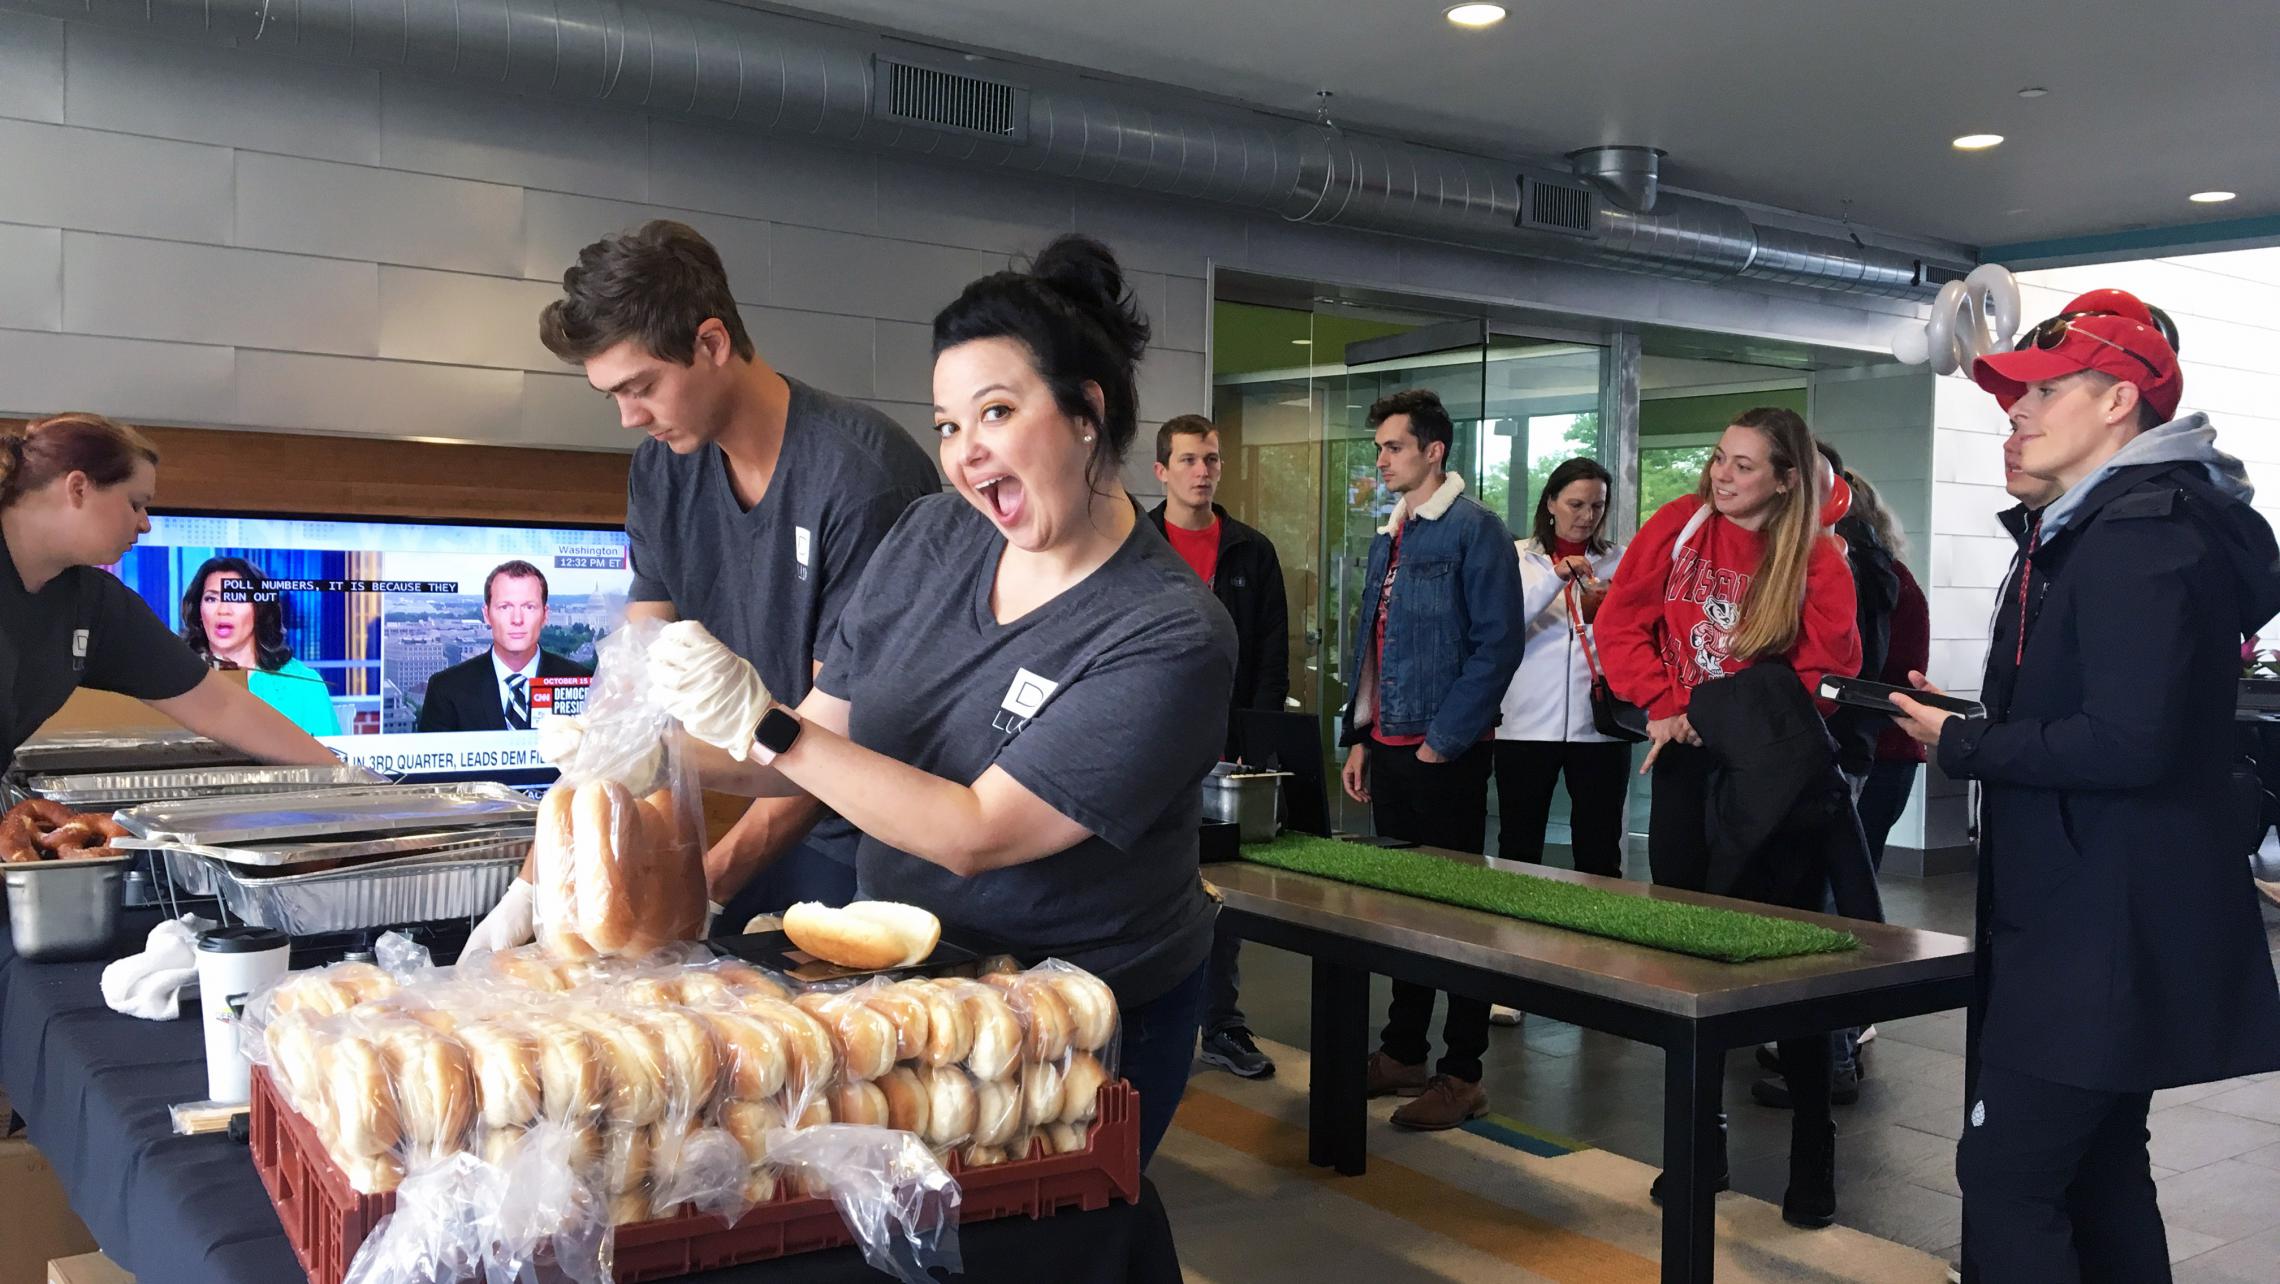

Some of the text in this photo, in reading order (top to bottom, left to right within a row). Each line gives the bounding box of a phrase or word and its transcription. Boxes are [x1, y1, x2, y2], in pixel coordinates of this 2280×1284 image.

[559, 546, 618, 557] Washington
[560, 558, 622, 568] 12:32 PM ET
[223, 580, 456, 592] POLL NUMBERS, IT IS BECAUSE THEY
[223, 592, 277, 602] RUN OUT
[543, 677, 578, 685] OCTOBER
[579, 677, 588, 685] 15
[533, 693, 551, 703] CNN
[353, 756, 365, 768] IN
[369, 755, 394, 771] 3RD
[397, 752, 457, 771] QUARTER,
[460, 751, 498, 767] LEADS
[501, 750, 526, 766] DEM
